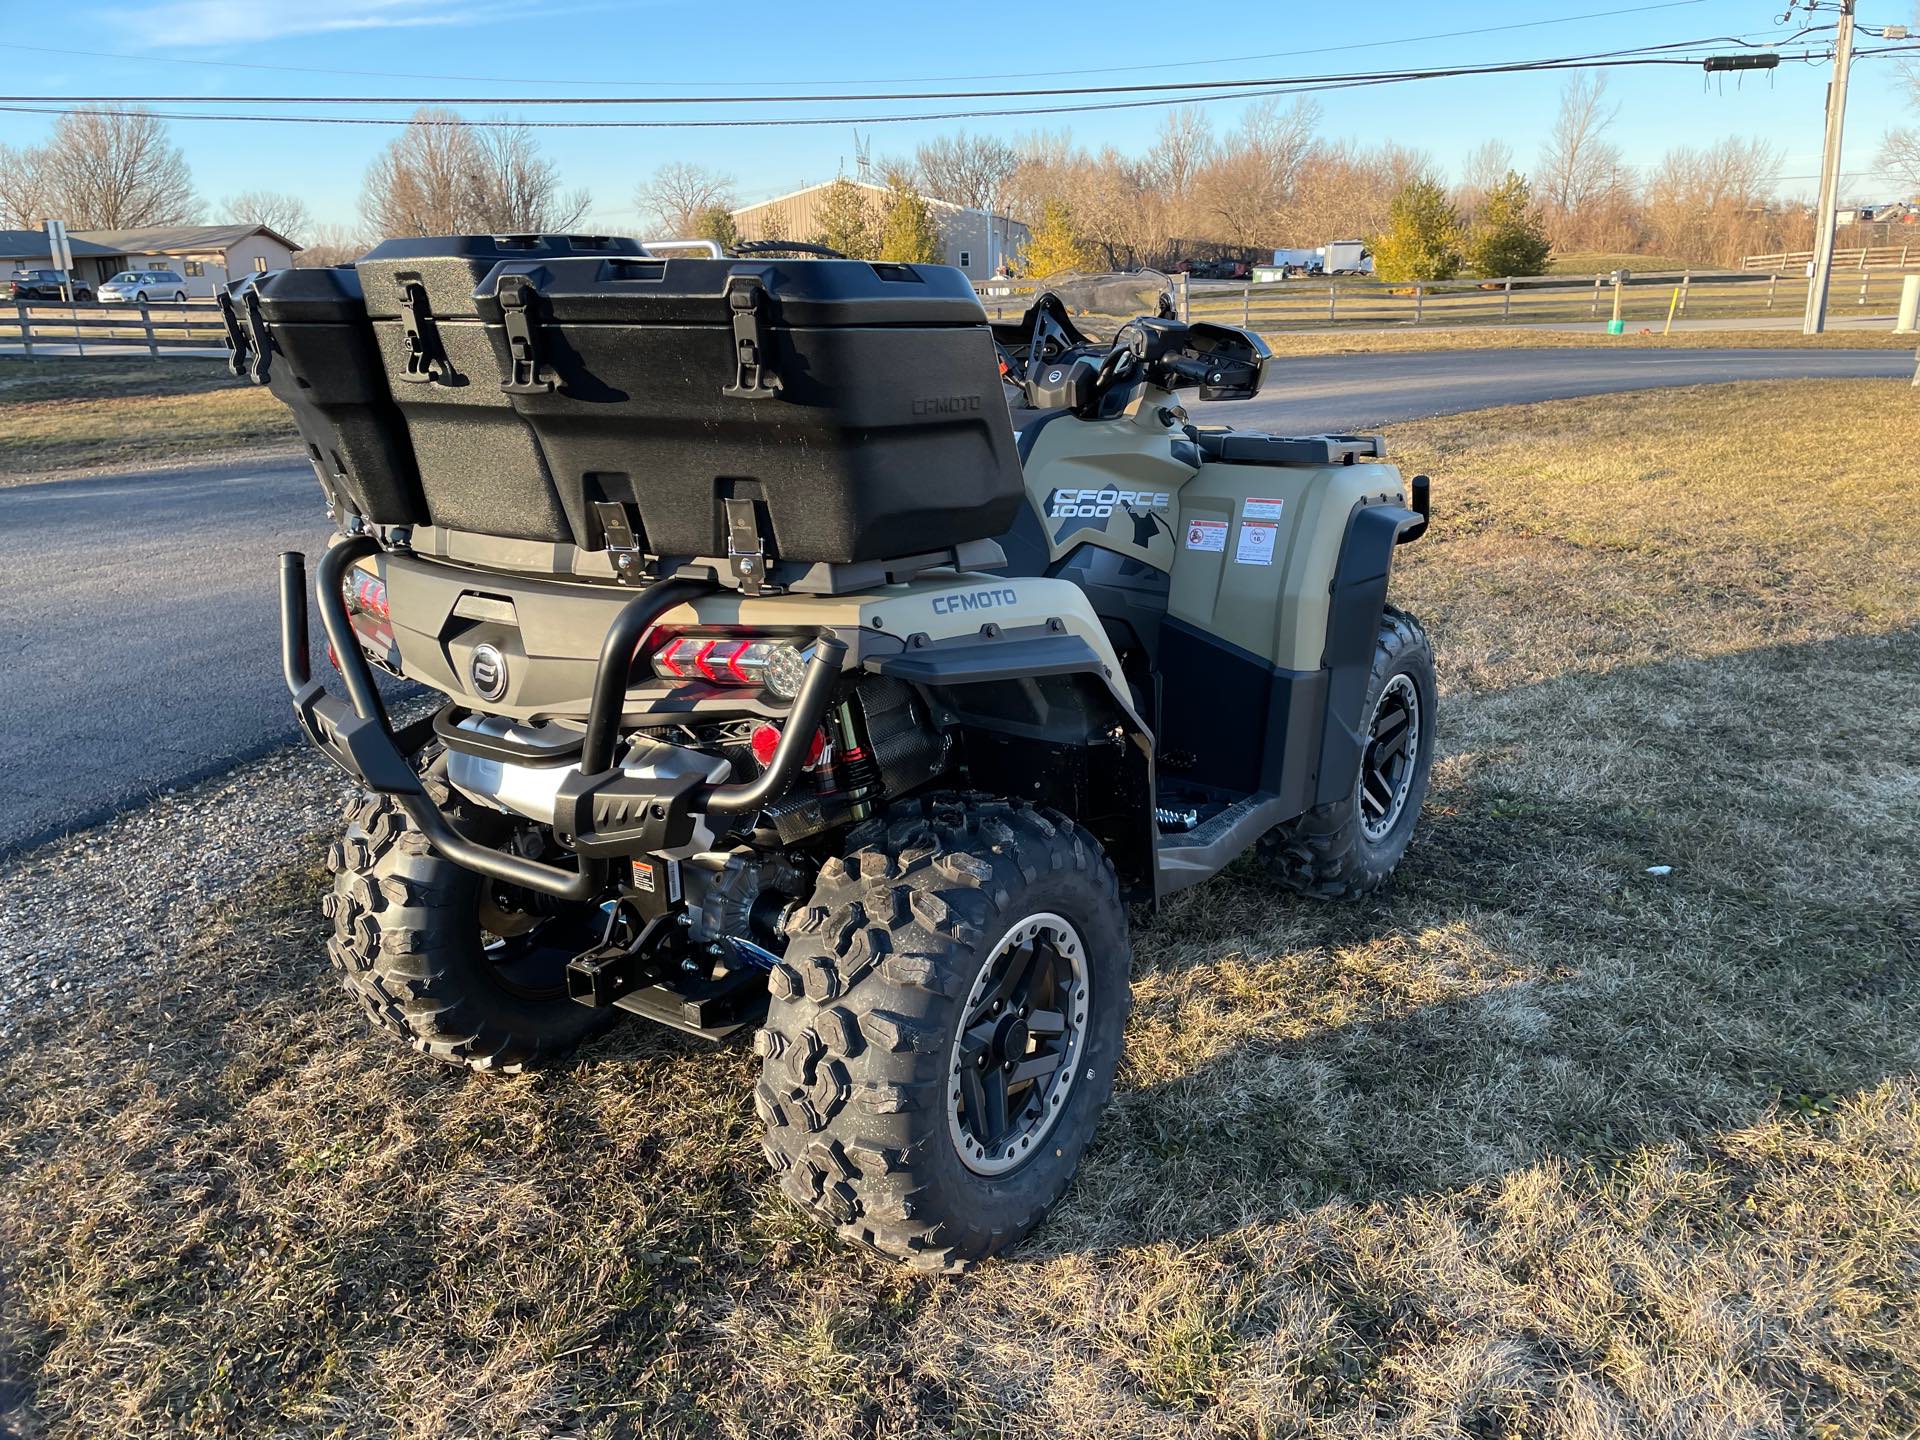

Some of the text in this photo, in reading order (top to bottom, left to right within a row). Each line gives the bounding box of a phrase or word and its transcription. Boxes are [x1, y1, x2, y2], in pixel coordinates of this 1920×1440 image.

[912, 395, 981, 415] CFMOTO
[1054, 489, 1170, 506] CFORCE
[1051, 504, 1113, 518] 1000
[932, 589, 1017, 615] CFMOTO
